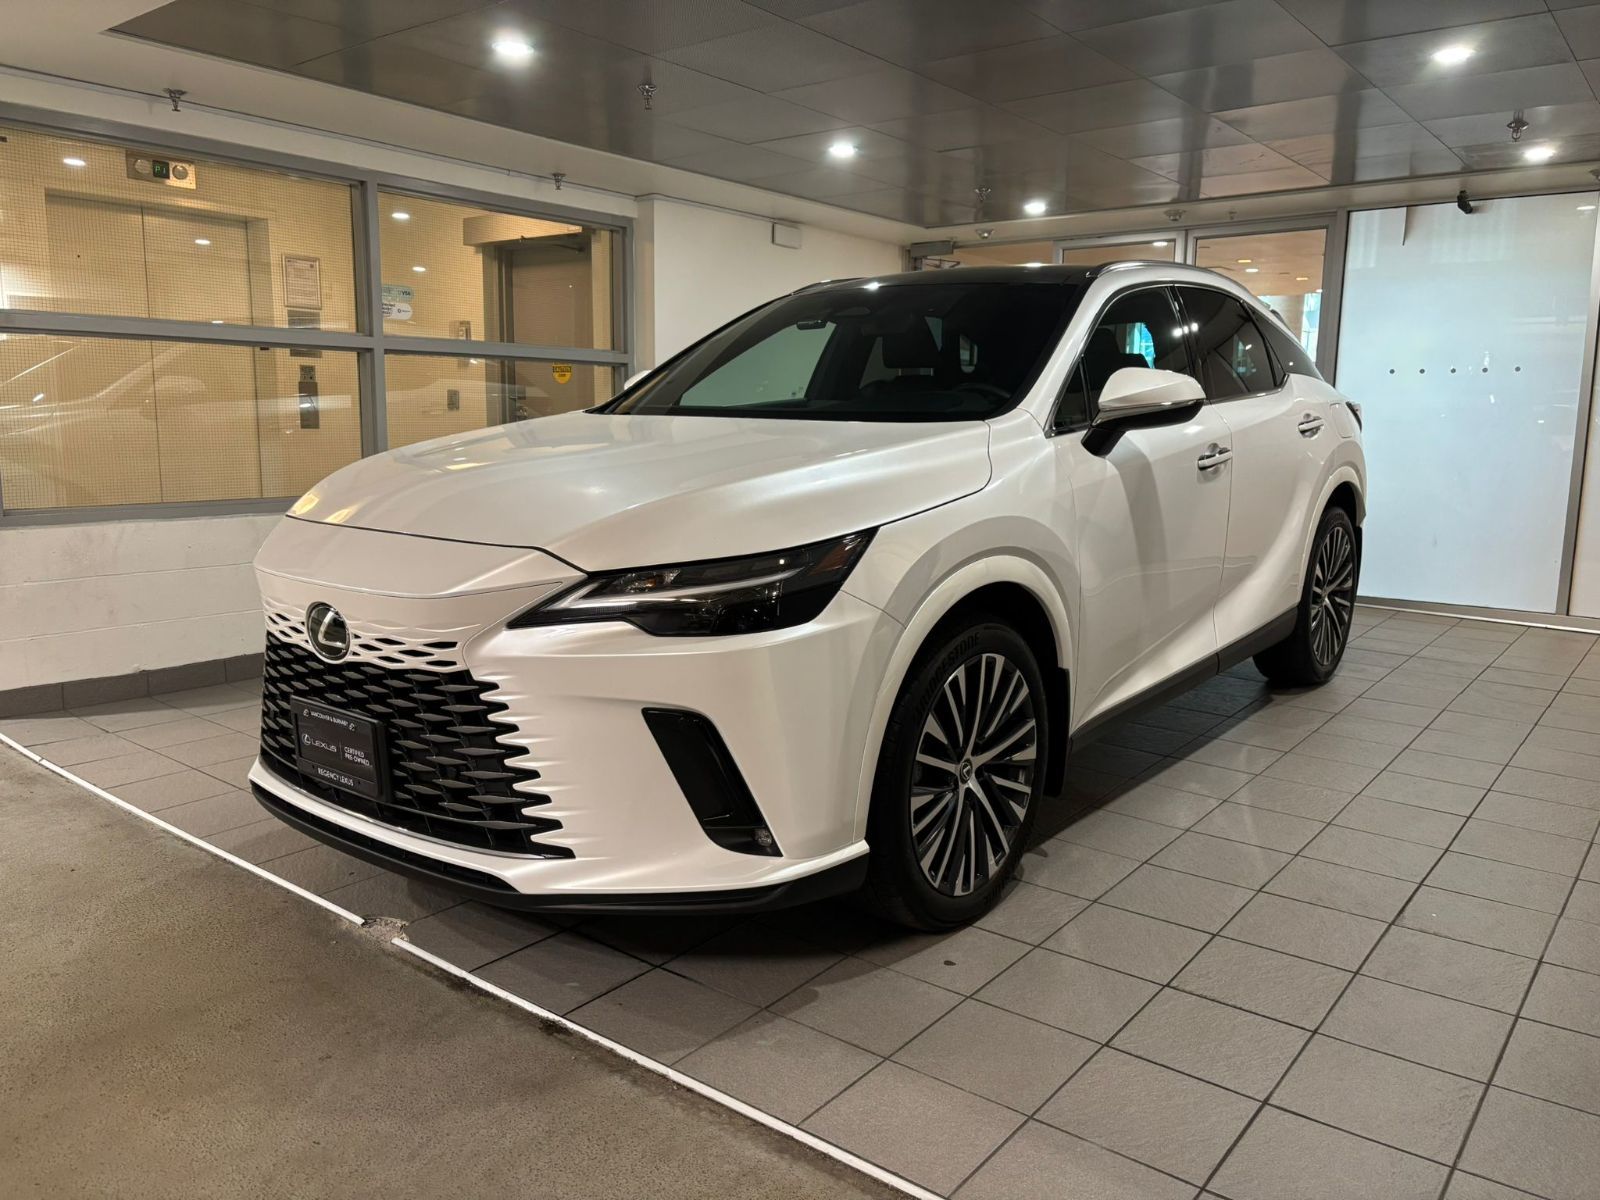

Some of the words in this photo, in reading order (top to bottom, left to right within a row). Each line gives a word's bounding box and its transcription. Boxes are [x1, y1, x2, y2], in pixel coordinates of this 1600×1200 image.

[311, 738, 337, 752] LEXUS
[344, 746, 365, 758] CERTIFIED
[344, 753, 370, 766] PRE-OWNED
[317, 767, 339, 781] REGENCY
[340, 775, 354, 786] LEXUS
